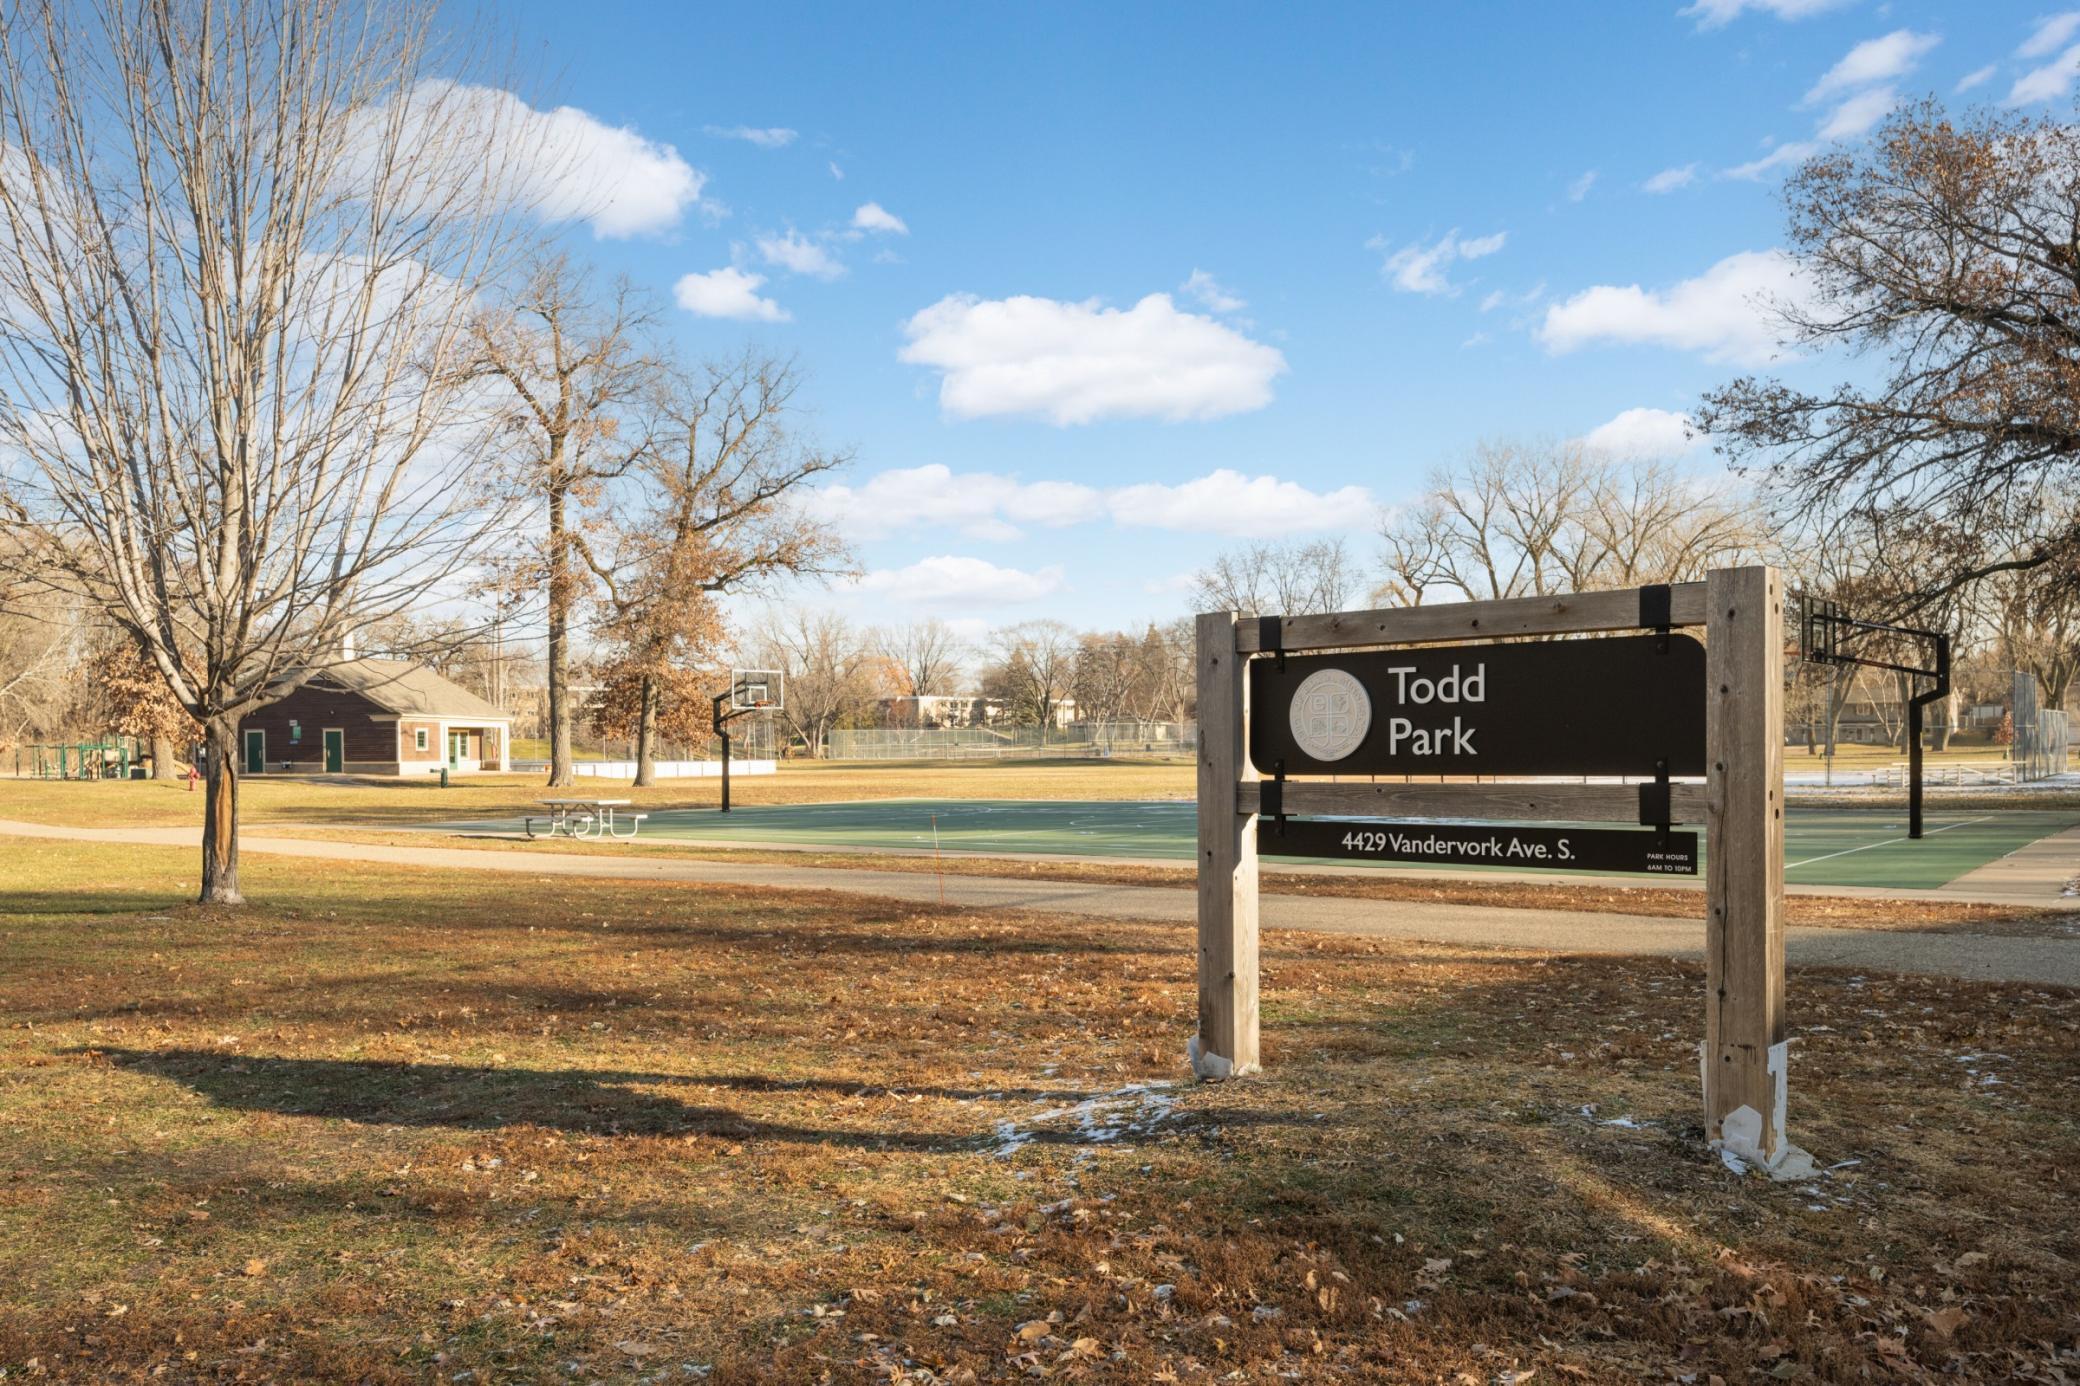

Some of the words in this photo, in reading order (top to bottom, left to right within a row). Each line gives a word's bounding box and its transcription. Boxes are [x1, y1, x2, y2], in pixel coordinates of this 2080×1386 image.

[1388, 663, 1485, 704] Todd
[1390, 716, 1478, 755] Park
[1342, 832, 1386, 852] 4429
[1389, 833, 1503, 857] Vandervork
[1507, 838, 1552, 859] Ave.
[1557, 839, 1576, 860] S.
